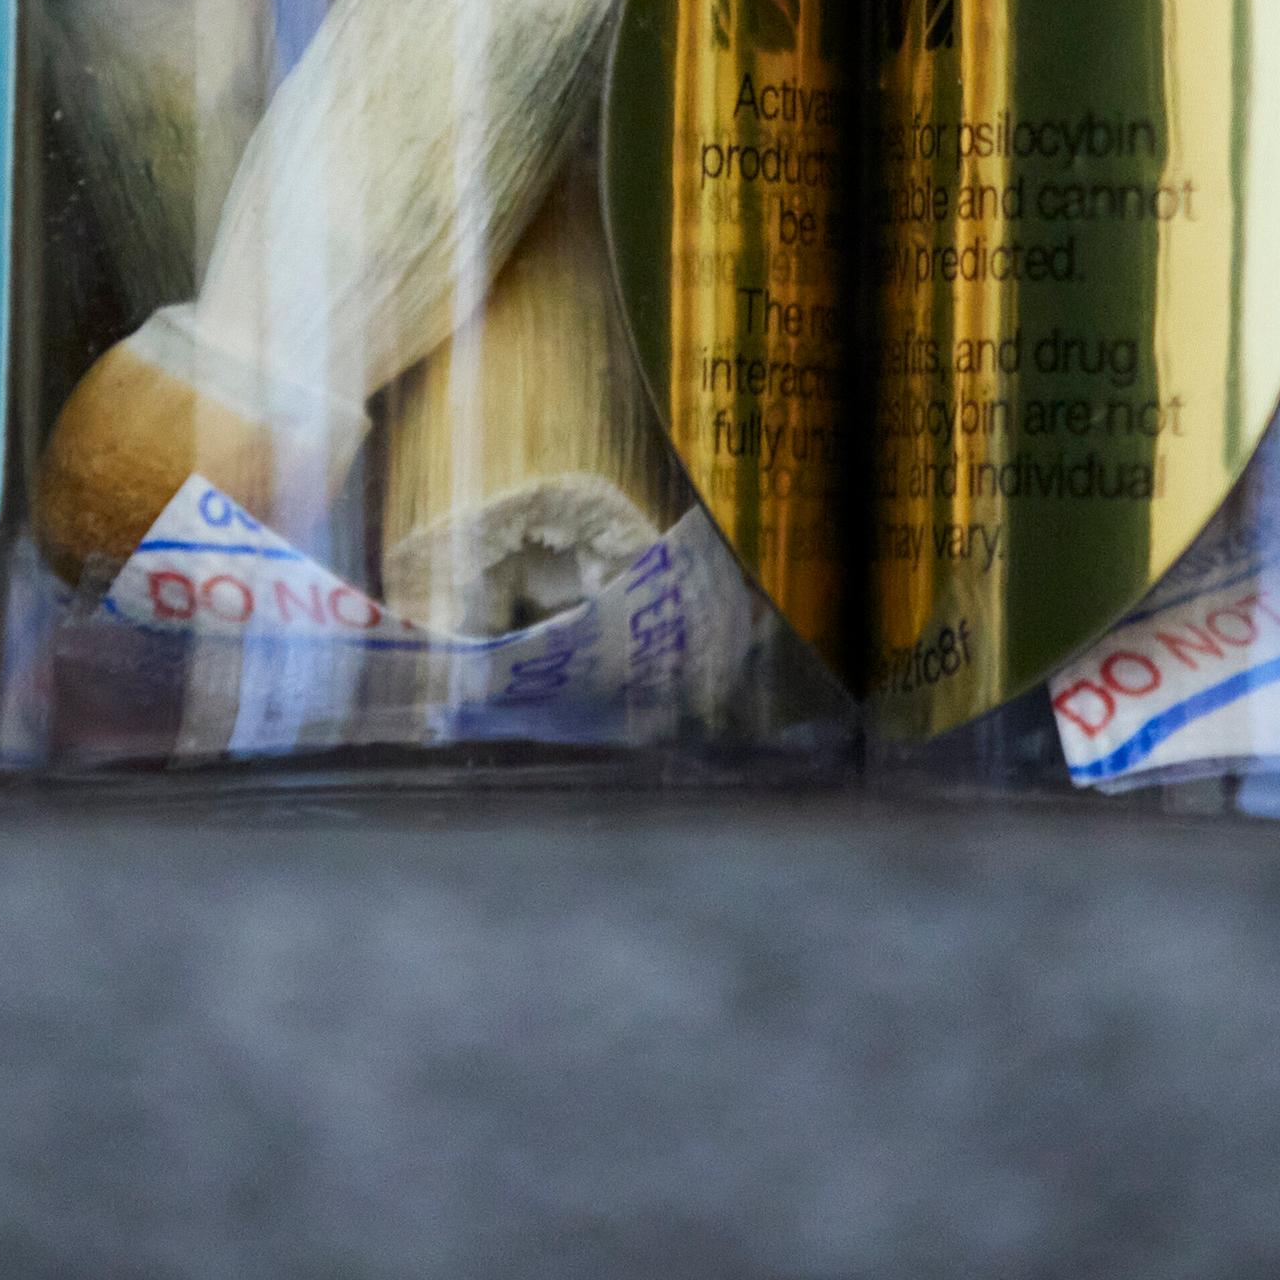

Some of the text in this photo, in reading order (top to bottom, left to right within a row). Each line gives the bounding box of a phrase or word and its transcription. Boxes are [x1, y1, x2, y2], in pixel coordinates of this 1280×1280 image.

[732, 73, 837, 126] Activa
[911, 111, 949, 162] for
[953, 108, 1158, 184] psilocybin
[777, 193, 818, 246] be
[914, 235, 1085, 291] predicted.
[956, 176, 1020, 221] and
[1035, 178, 1196, 222] cannot
[736, 287, 803, 338] The
[955, 326, 1020, 376] and
[1032, 326, 1139, 386] drug
[700, 346, 836, 398] interac
[887, 387, 1011, 447] silocybin
[1025, 398, 1092, 438] are
[1099, 394, 1187, 439] not
[709, 409, 787, 473] fully
[906, 453, 958, 501] and
[966, 450, 1166, 502] individual
[930, 520, 1005, 575] vary.
[147, 569, 414, 631] DO NO
[1052, 648, 1161, 740] DO
